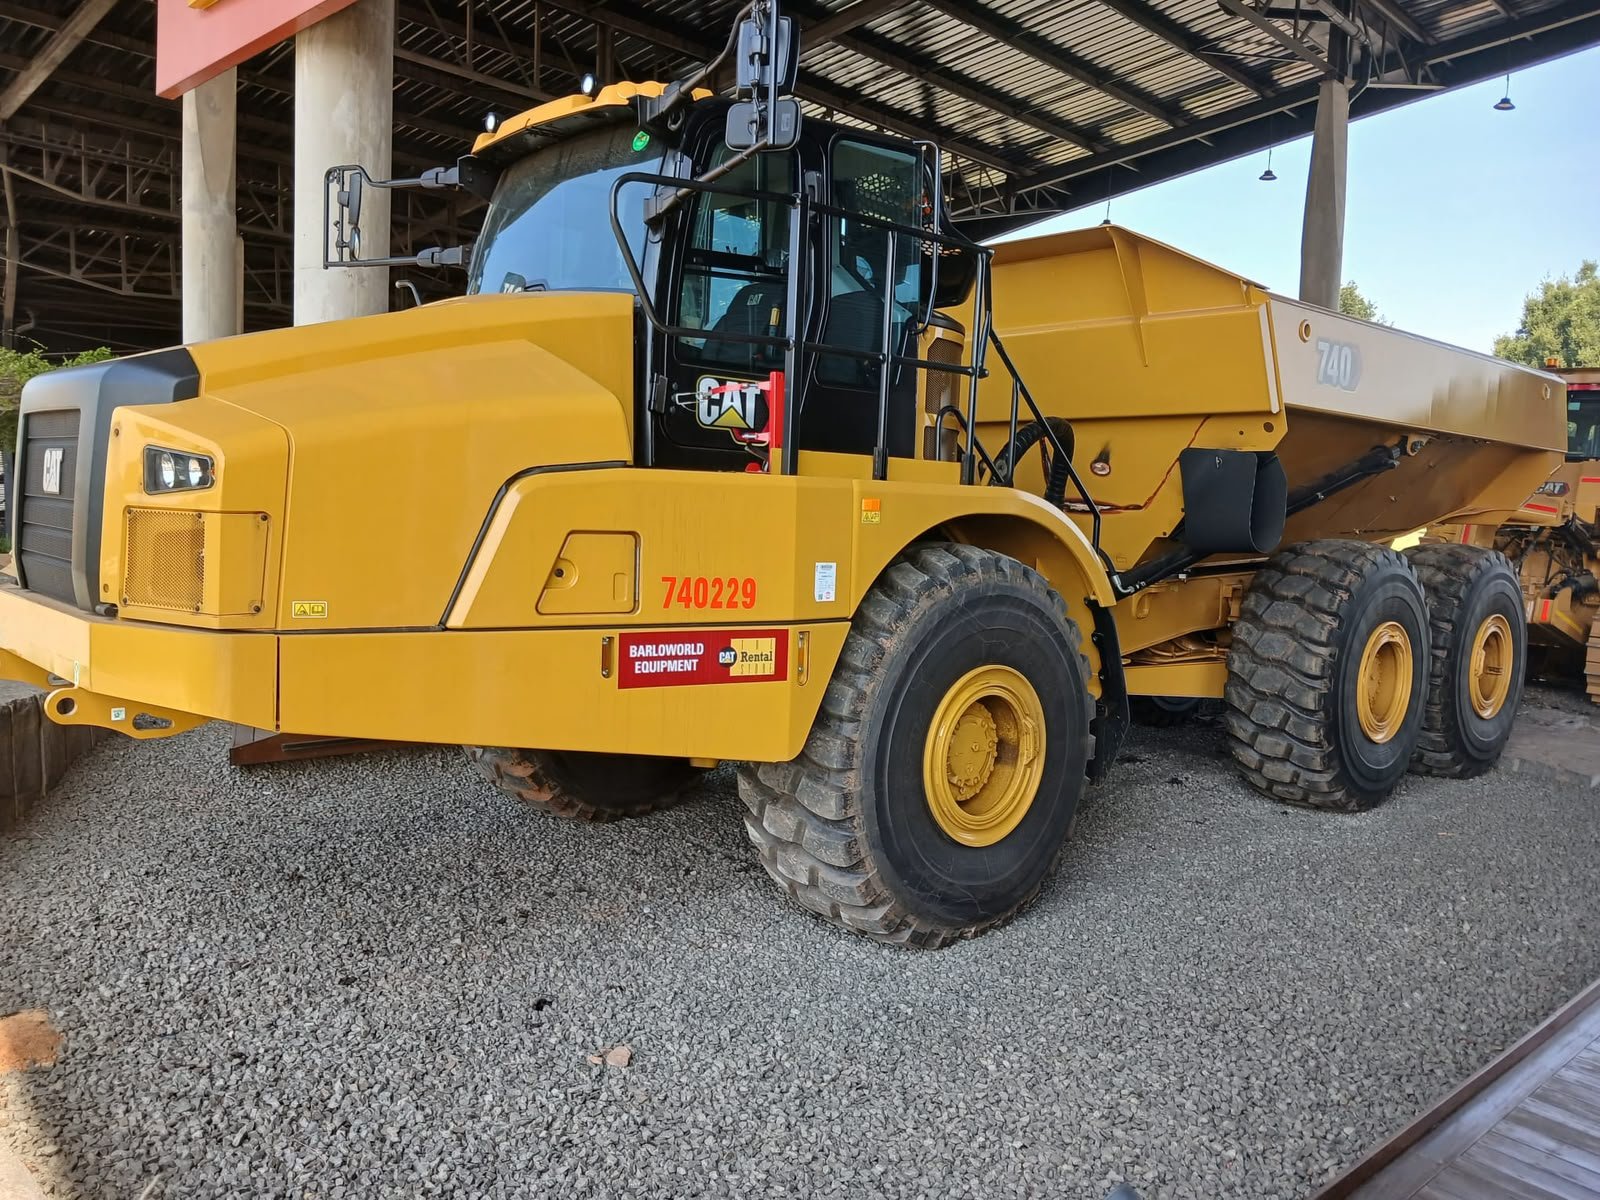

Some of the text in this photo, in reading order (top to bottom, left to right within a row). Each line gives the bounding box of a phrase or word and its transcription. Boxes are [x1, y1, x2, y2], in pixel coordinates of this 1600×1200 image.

[1317, 340, 1352, 387] 740
[699, 377, 761, 429] CAT
[43, 447, 64, 494] CAT
[661, 576, 756, 609] 740229
[629, 643, 704, 658] BARLOWORLD
[634, 659, 699, 674] EQUIPMENT
[719, 651, 773, 664] CAT Rental
